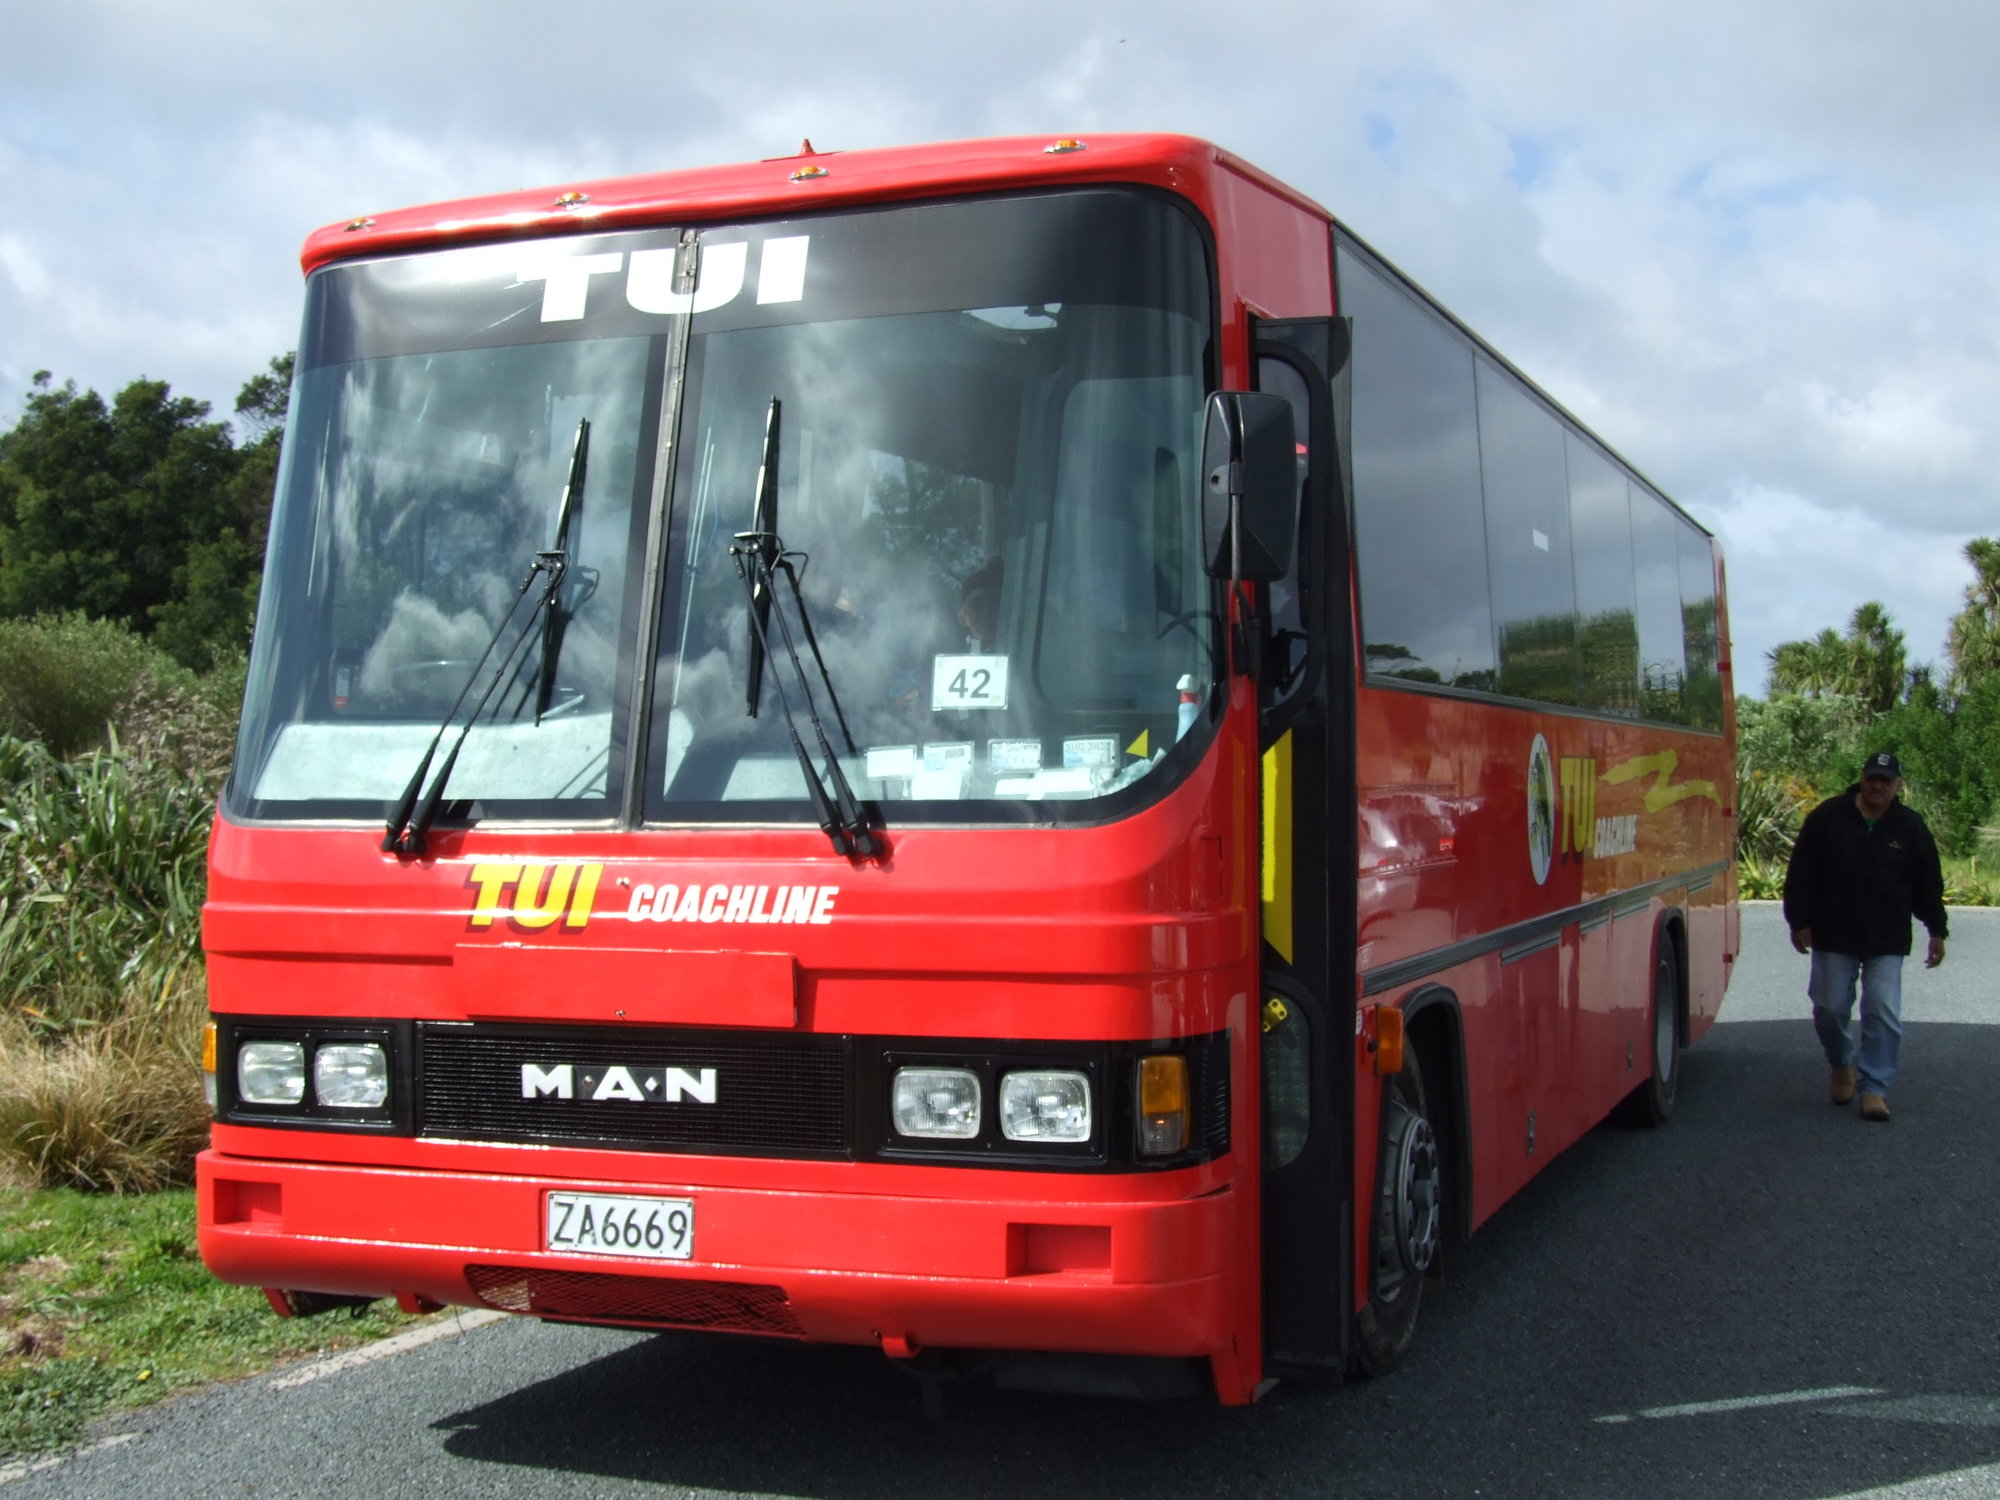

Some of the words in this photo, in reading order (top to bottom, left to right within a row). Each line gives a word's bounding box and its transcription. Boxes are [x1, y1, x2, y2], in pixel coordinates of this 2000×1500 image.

[515, 235, 810, 323] TUI
[948, 668, 991, 699] 42
[1560, 757, 1596, 854] TUI
[468, 862, 605, 929] TUI
[627, 883, 840, 925] COACHLINE
[553, 1201, 688, 1251] ZA6669
